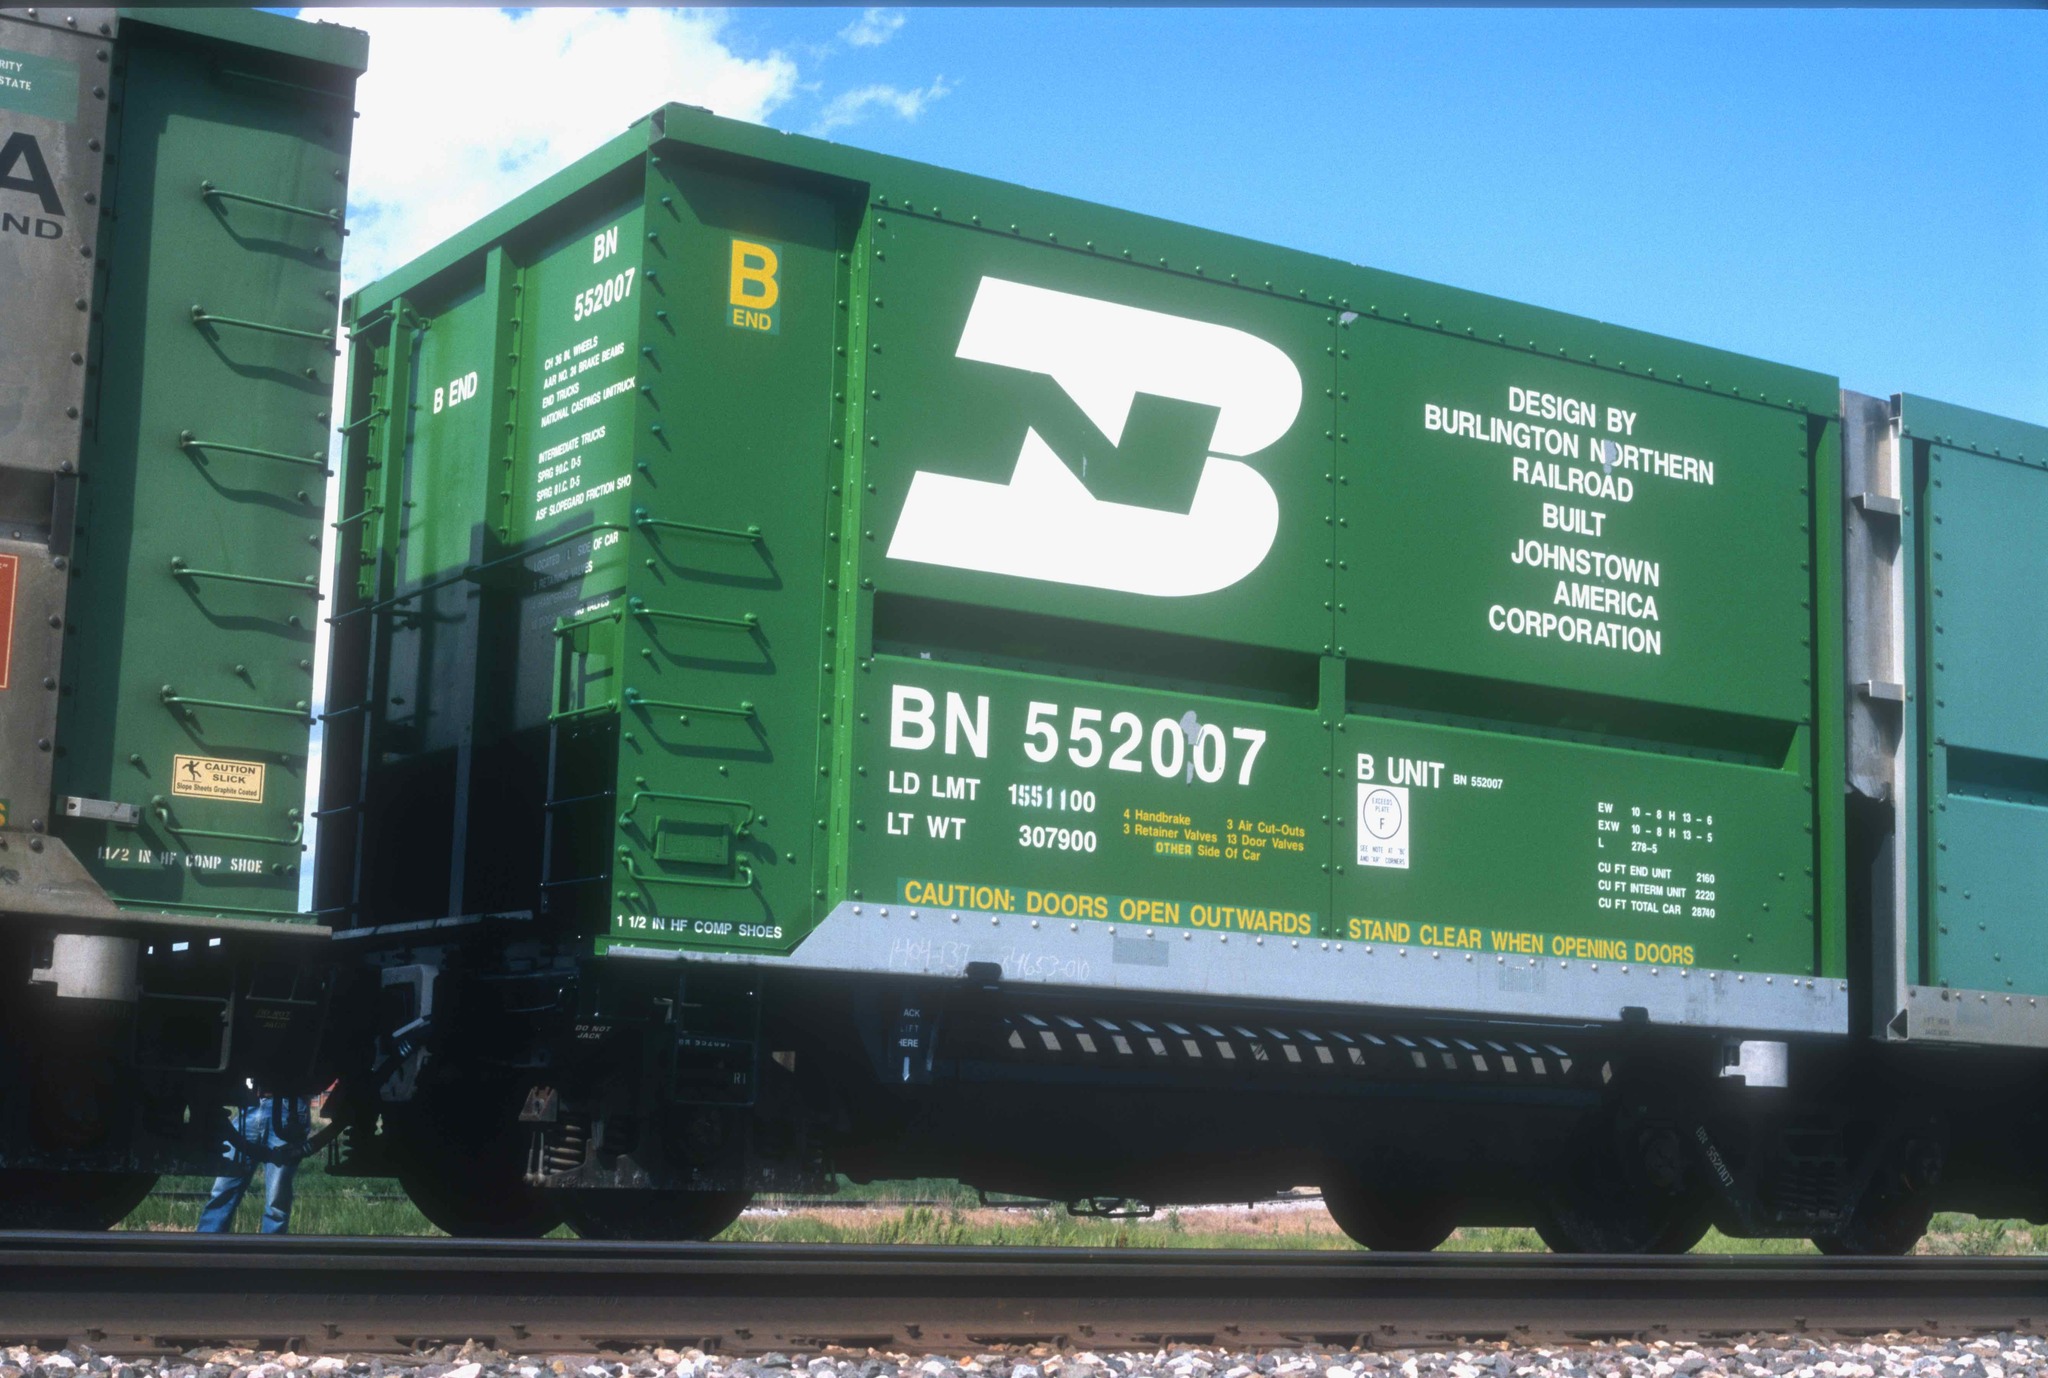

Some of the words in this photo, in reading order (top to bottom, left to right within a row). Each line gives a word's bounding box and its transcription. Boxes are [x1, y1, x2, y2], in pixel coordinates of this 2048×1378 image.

[2, 213, 63, 240] ND
[593, 226, 618, 264] BN
[729, 239, 779, 310] B
[573, 268, 635, 322] 552007
[733, 309, 771, 331] END
[544, 358, 553, 370] CH
[555, 354, 562, 365] 36
[573, 336, 598, 356] WHEELS
[544, 375, 556, 390] AAR
[579, 354, 600, 373] BRAKE
[602, 342, 624, 362] BEAMS
[434, 388, 443, 414] B
[449, 372, 477, 407] END
[541, 406, 569, 427] NATIONAL
[571, 392, 601, 414] CASTINGS
[603, 376, 635, 399] UNITRUCK
[542, 395, 554, 409] END
[557, 383, 579, 402] TRUCKS
[1509, 386, 1596, 428] DESIGN
[1607, 408, 1637, 435] BY
[538, 437, 579, 464] INTERMEDIATE
[581, 426, 606, 445] TRUCKS
[1425, 404, 1578, 459] BURLINGTON
[538, 467, 553, 483] SPRG
[571, 456, 581, 469] D-5
[1512, 457, 1634, 503] RAILROAD
[535, 507, 547, 521] ASF
[549, 493, 584, 516] SLOPEGARD
[586, 481, 614, 501] FRICTION
[537, 487, 552, 502] SPRG
[570, 475, 580, 488] D-5
[1543, 503, 1606, 536] BUILT
[593, 537, 602, 550] OF
[605, 531, 619, 546] CAR
[1511, 539, 1660, 587] JOHNSTOWN
[1553, 580, 1659, 621] AMERICA
[1489, 605, 1661, 655] CORPORATION
[889, 684, 989, 758] BN
[1023, 702, 1267, 786] 552007
[205, 763, 256, 774] CAUTION
[213, 774, 246, 784] SLICK
[1358, 753, 1374, 780] B
[1388, 757, 1444, 788] UNIT
[1453, 774, 1467, 785] BN
[1471, 777, 1503, 789] 552007
[177, 782, 192, 790] Slope
[194, 784, 212, 792] Sheets
[214, 786, 236, 794] Graphite
[889, 771, 920, 795] LD
[932, 775, 981, 801] LMT
[1008, 783, 1096, 813] 1551100
[1123, 809, 1130, 819] 4
[1135, 810, 1190, 825] Handbrake
[1227, 819, 1233, 830] 3
[1239, 821, 1253, 831] Air
[1380, 818, 1385, 829] F
[1598, 802, 1613, 813] EW
[1632, 807, 1640, 817] 10
[1657, 810, 1662, 819] 8
[1669, 811, 1675, 821] H
[1683, 813, 1691, 822] 13
[1707, 816, 1712, 825] 6
[888, 812, 914, 835] LT
[927, 816, 966, 840] WT
[1019, 825, 1096, 853] 307900
[1123, 824, 1130, 834] 3
[1135, 825, 1178, 838] Retainer
[1184, 830, 1218, 842] Valves
[1227, 834, 1237, 844] 13
[1242, 836, 1266, 847] Door
[1272, 838, 1304, 851] Valves
[1598, 820, 1619, 832] EXW
[1632, 824, 1640, 834] 10
[1657, 827, 1662, 837] 8
[1669, 828, 1675, 838] H
[1683, 830, 1691, 840] 13
[1708, 833, 1712, 842] 5
[1156, 842, 1191, 855] OTHER
[1198, 846, 1220, 857] Side
[1225, 848, 1238, 858] Of
[1243, 849, 1261, 861] Car
[1598, 838, 1604, 848] L
[1632, 842, 1658, 853] 278-5
[138, 850, 151, 863] IN
[160, 852, 176, 865] HF
[186, 854, 222, 869] COMP
[230, 858, 263, 873] SHOE
[1598, 862, 1611, 872] CU
[1615, 864, 1626, 874] FT
[1630, 866, 1648, 876] END
[1652, 868, 1672, 879] UNIT
[1696, 873, 1714, 884] 2160
[1598, 880, 1611, 890] CU
[1615, 882, 1626, 892] FT
[1631, 883, 1663, 896] INTERM
[1667, 887, 1686, 898] UNIT
[1695, 890, 1715, 901] 2220
[905, 880, 1016, 912] CAUTION:
[1027, 891, 1108, 919] DOORS
[1119, 899, 1179, 924] OPEN
[1191, 904, 1311, 935] OUTWARDS
[1598, 898, 1611, 908] CU
[1615, 899, 1627, 910] FT
[1631, 901, 1658, 913] TOTAL
[1662, 904, 1681, 914] CAR
[1692, 907, 1715, 918] 28740
[617, 915, 622, 927] 1
[629, 916, 647, 929] 1/2
[652, 918, 664, 930] IN
[671, 919, 688, 932] HF
[694, 921, 732, 935] COMP
[739, 924, 782, 939] SHOES
[1349, 918, 1410, 943] STAND
[1420, 924, 1482, 949] CLEAR
[1491, 930, 1544, 954] WHEN
[1552, 935, 1627, 960] OPENING
[1635, 942, 1694, 965] DOORS
[904, 1009, 920, 1017] ACK
